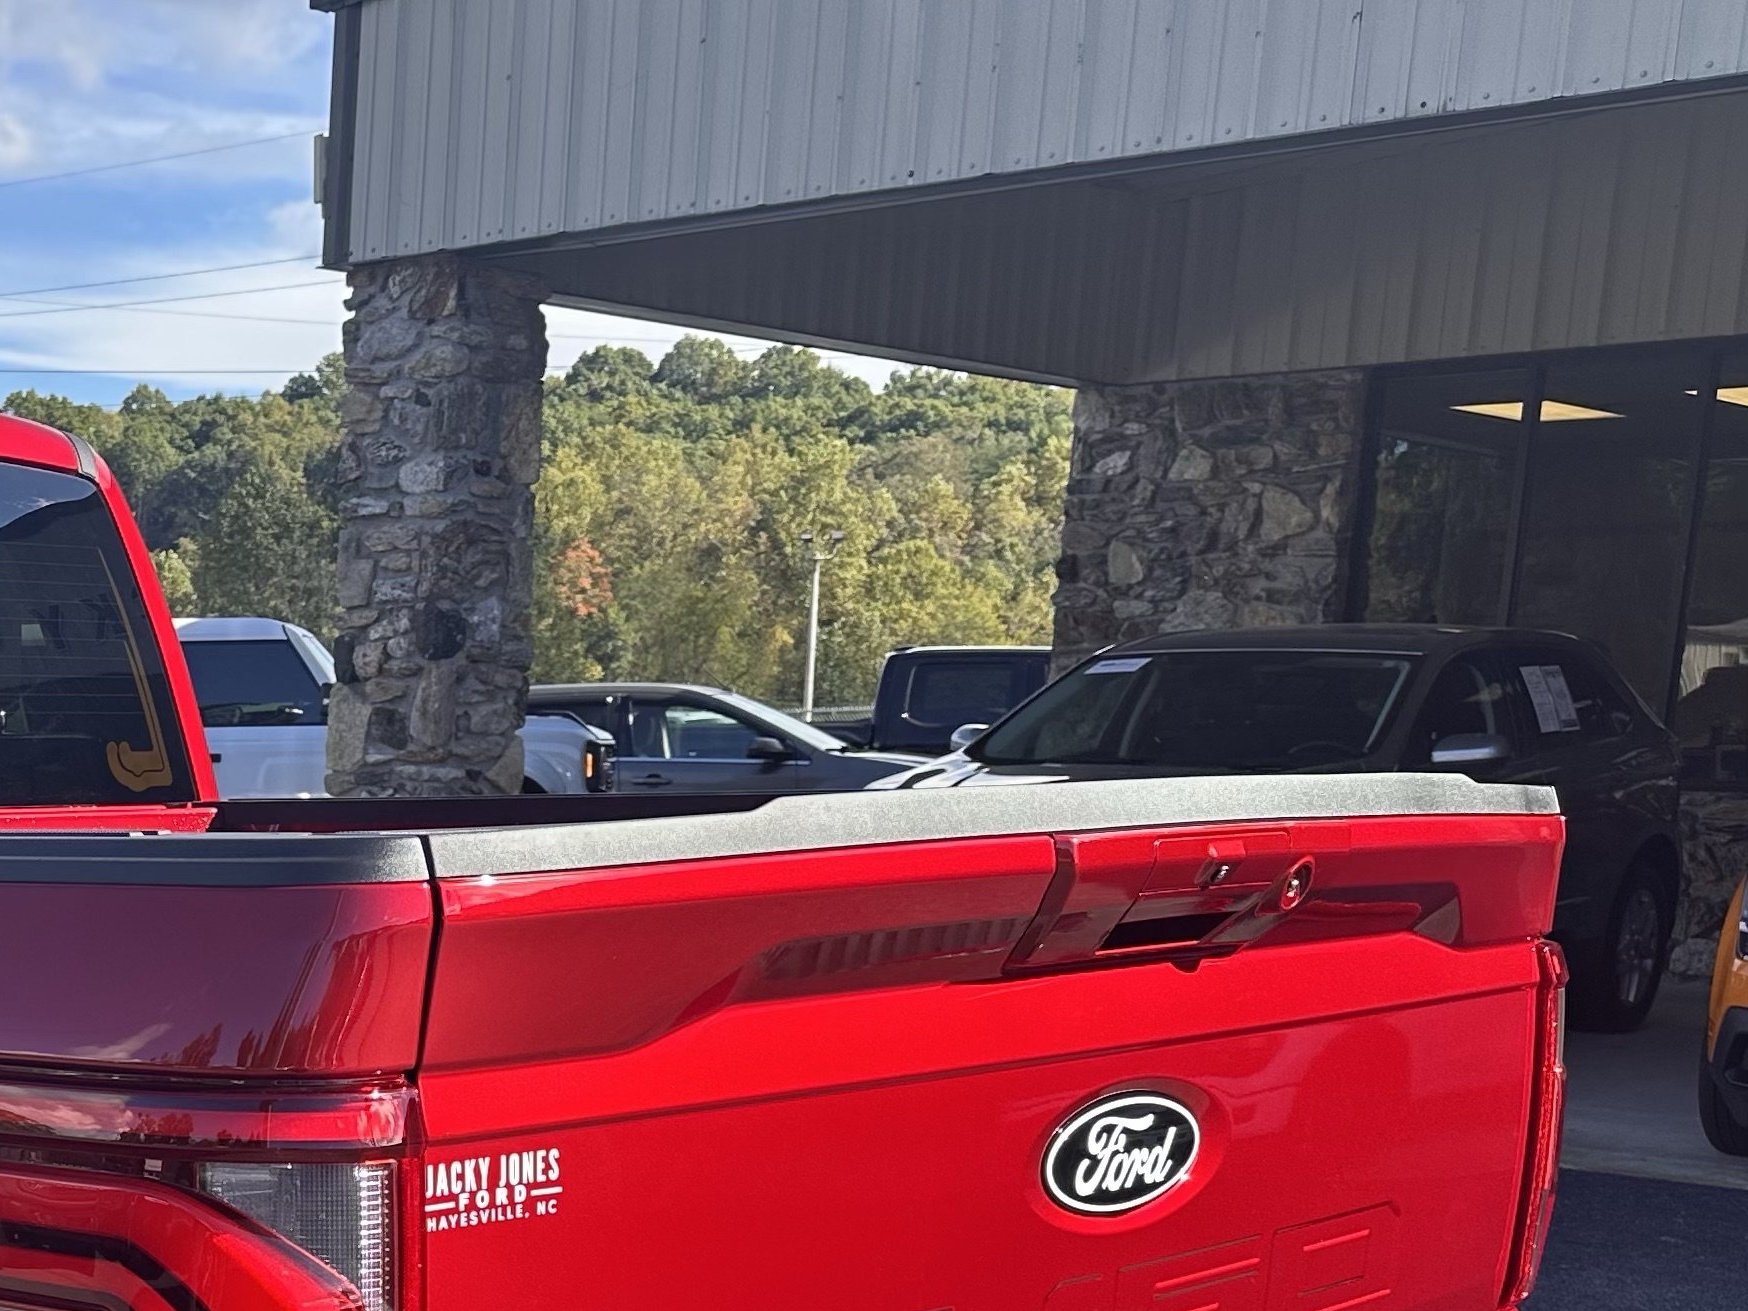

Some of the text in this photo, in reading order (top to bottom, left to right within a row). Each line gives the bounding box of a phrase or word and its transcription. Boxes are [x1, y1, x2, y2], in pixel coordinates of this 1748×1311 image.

[425, 1148, 560, 1199] JACKY JONES
[1075, 1113, 1178, 1197] Ford
[426, 1199, 558, 1232] HAYESVILLE, NC
[458, 1184, 527, 1212] FORD
